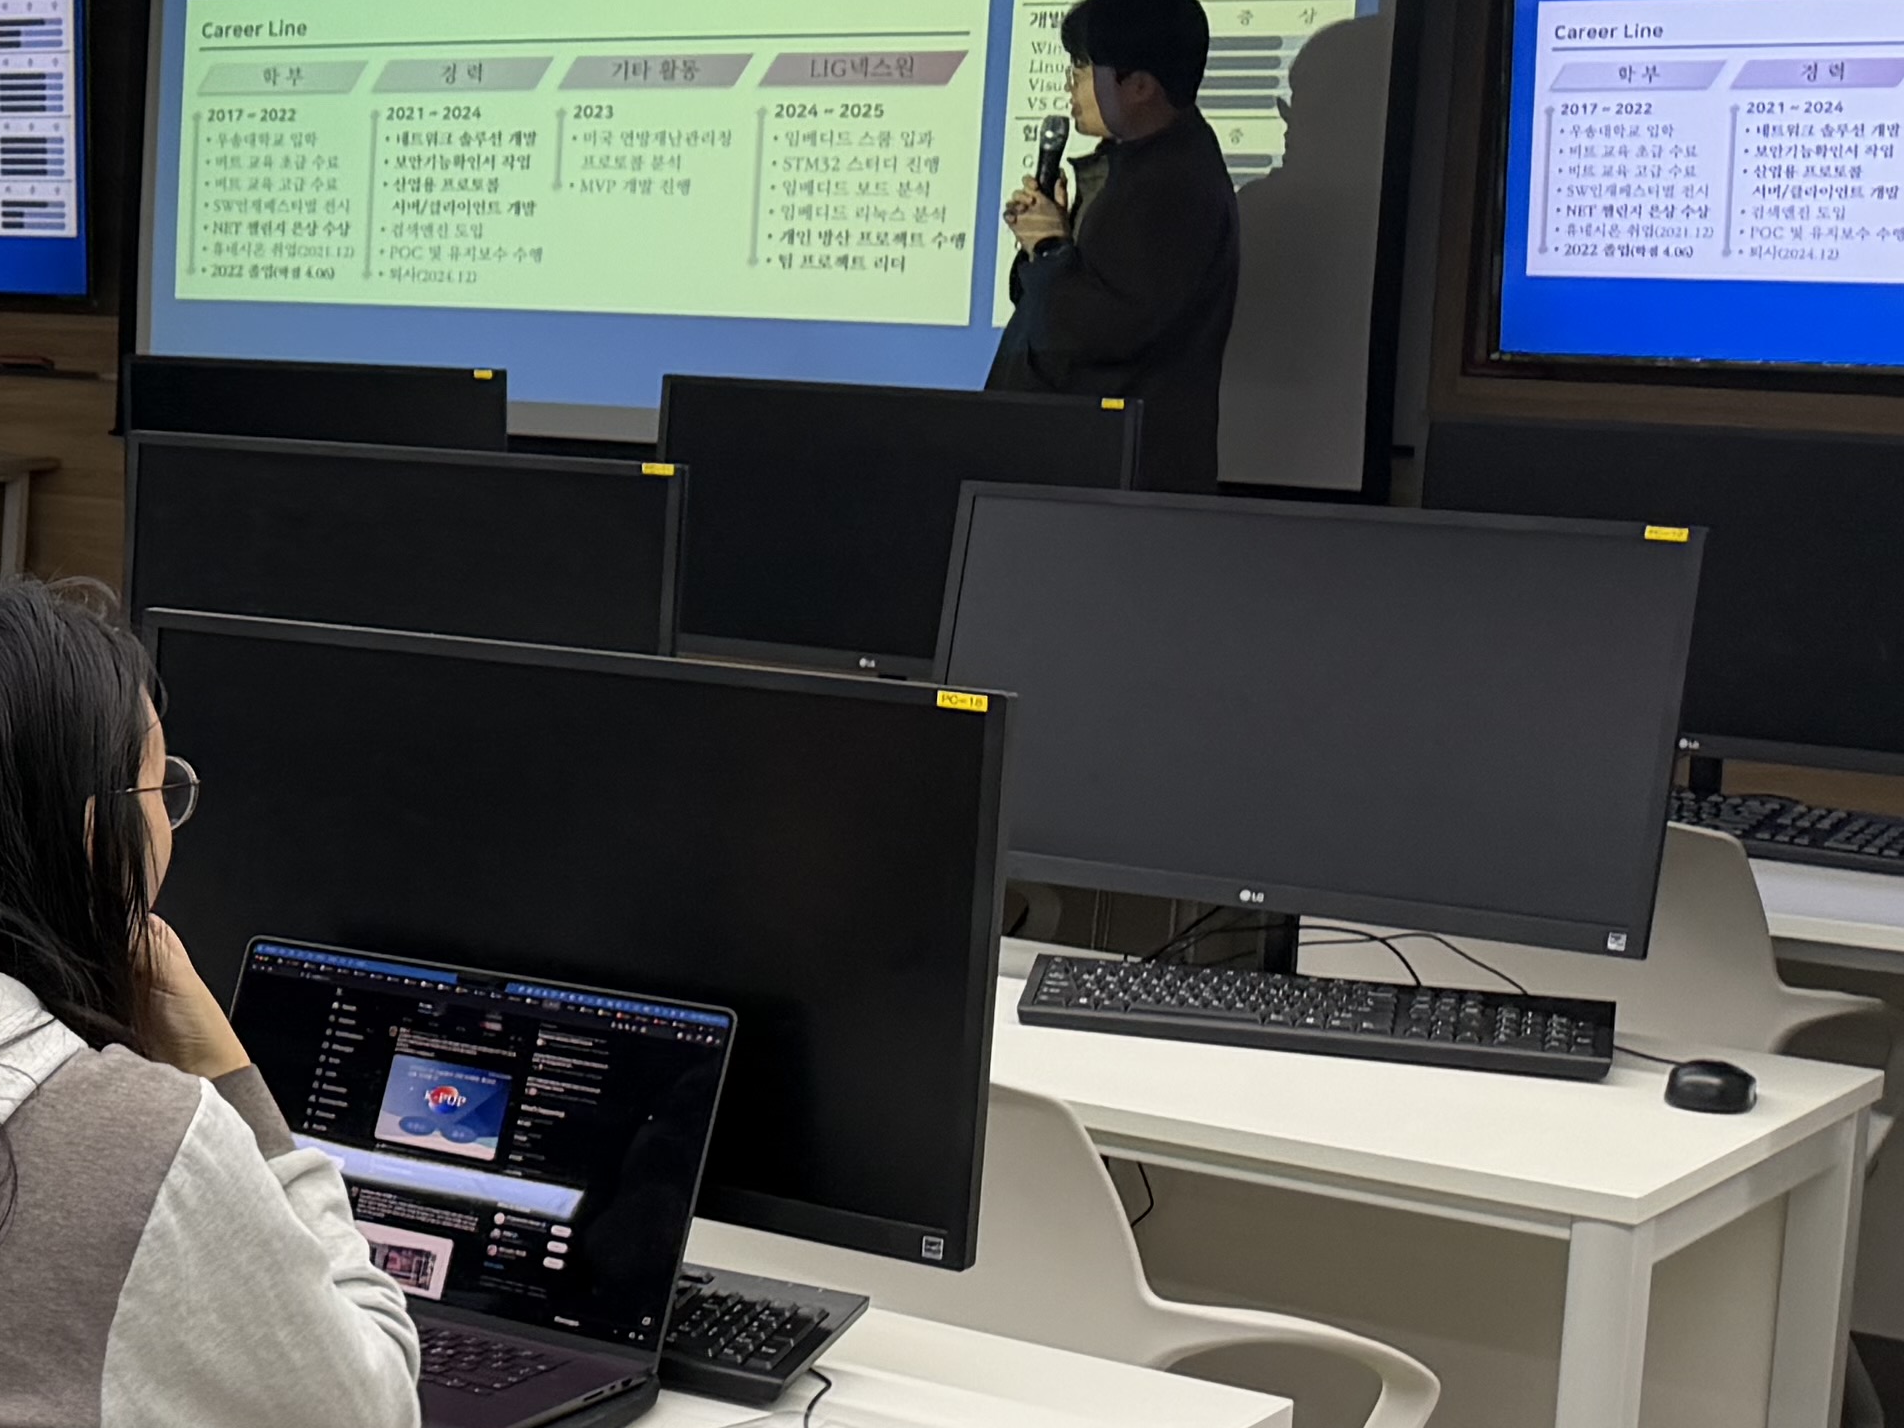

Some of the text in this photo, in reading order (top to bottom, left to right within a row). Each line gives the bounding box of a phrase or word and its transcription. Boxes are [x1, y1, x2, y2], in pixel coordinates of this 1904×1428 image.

[202, 20, 307, 39] Career Line
[1555, 24, 1663, 40] Career Line
